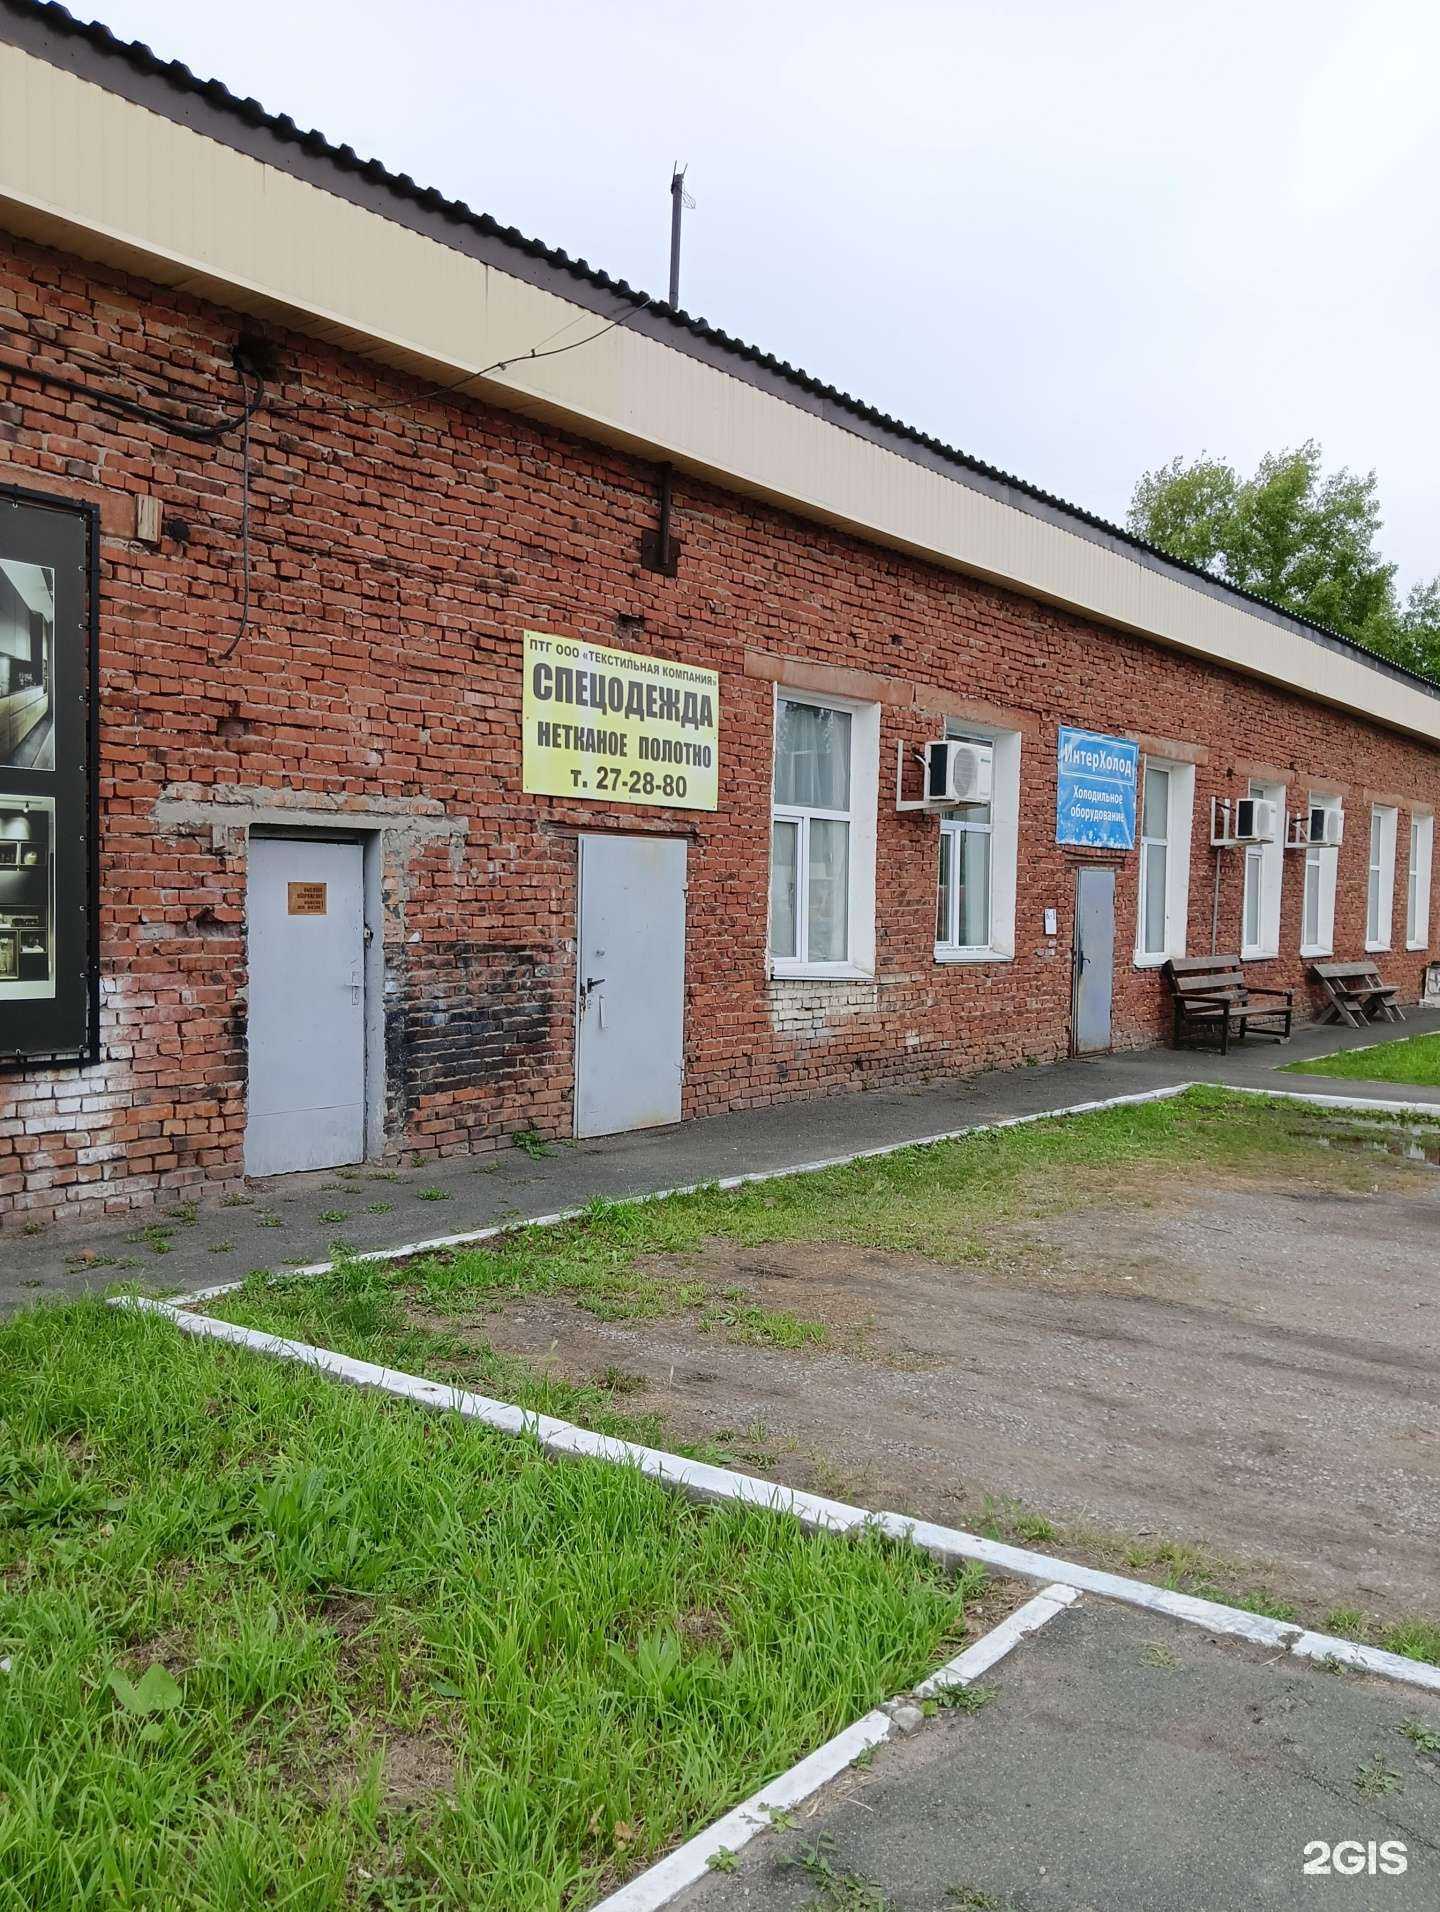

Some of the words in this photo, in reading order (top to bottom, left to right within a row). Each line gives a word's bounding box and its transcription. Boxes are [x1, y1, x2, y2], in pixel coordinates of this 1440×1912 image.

[529, 638, 552, 653] ПТГ
[556, 644, 580, 659] ООО
[582, 650, 660, 676] «ТЕКСТИЛЬНАЯ
[662, 667, 717, 687] КОМПАНИЯ»
[532, 662, 714, 730] СПЕЦОДЕЖДА
[537, 721, 628, 757] НЕТКАНОЕ
[638, 736, 712, 768] ПОЛОТНО
[1063, 743, 1133, 777] ИнтерХолод
[570, 769, 588, 788] т.
[596, 766, 687, 798] 27-28-80
[1073, 784, 1123, 804] Холодильное
[1070, 804, 1125, 823] оборудование
